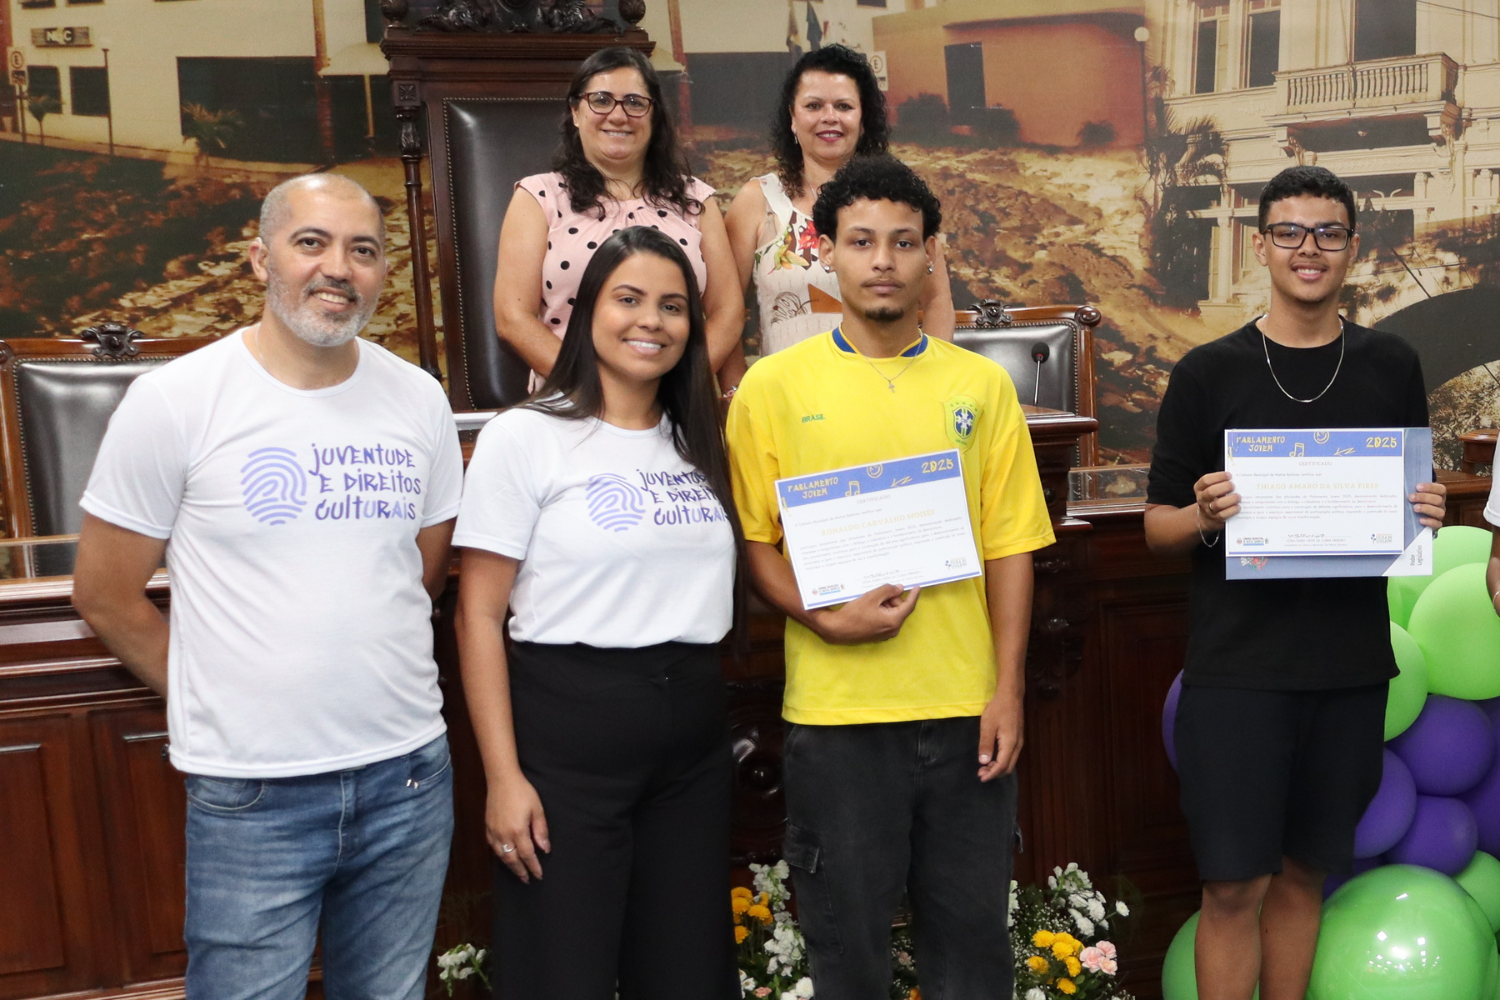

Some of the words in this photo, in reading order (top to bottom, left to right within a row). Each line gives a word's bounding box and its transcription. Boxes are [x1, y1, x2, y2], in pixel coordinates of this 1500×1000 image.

[801, 413, 826, 424] BRASIL
[1236, 436, 1286, 444] PARLAMENTO
[1365, 436, 1398, 449] 2025
[1248, 444, 1273, 452] JOVEM
[309, 443, 416, 476] JUVENTUDE
[921, 458, 954, 474] 2025
[344, 468, 422, 495] DIREITOS
[636, 468, 708, 492] JUVENTUD
[788, 476, 839, 493] PARLAMENTO
[1358, 482, 1379, 490] PIRES
[667, 483, 718, 503] DIREIT
[803, 488, 828, 499] JOVEM
[315, 494, 416, 520] CULTURAIS
